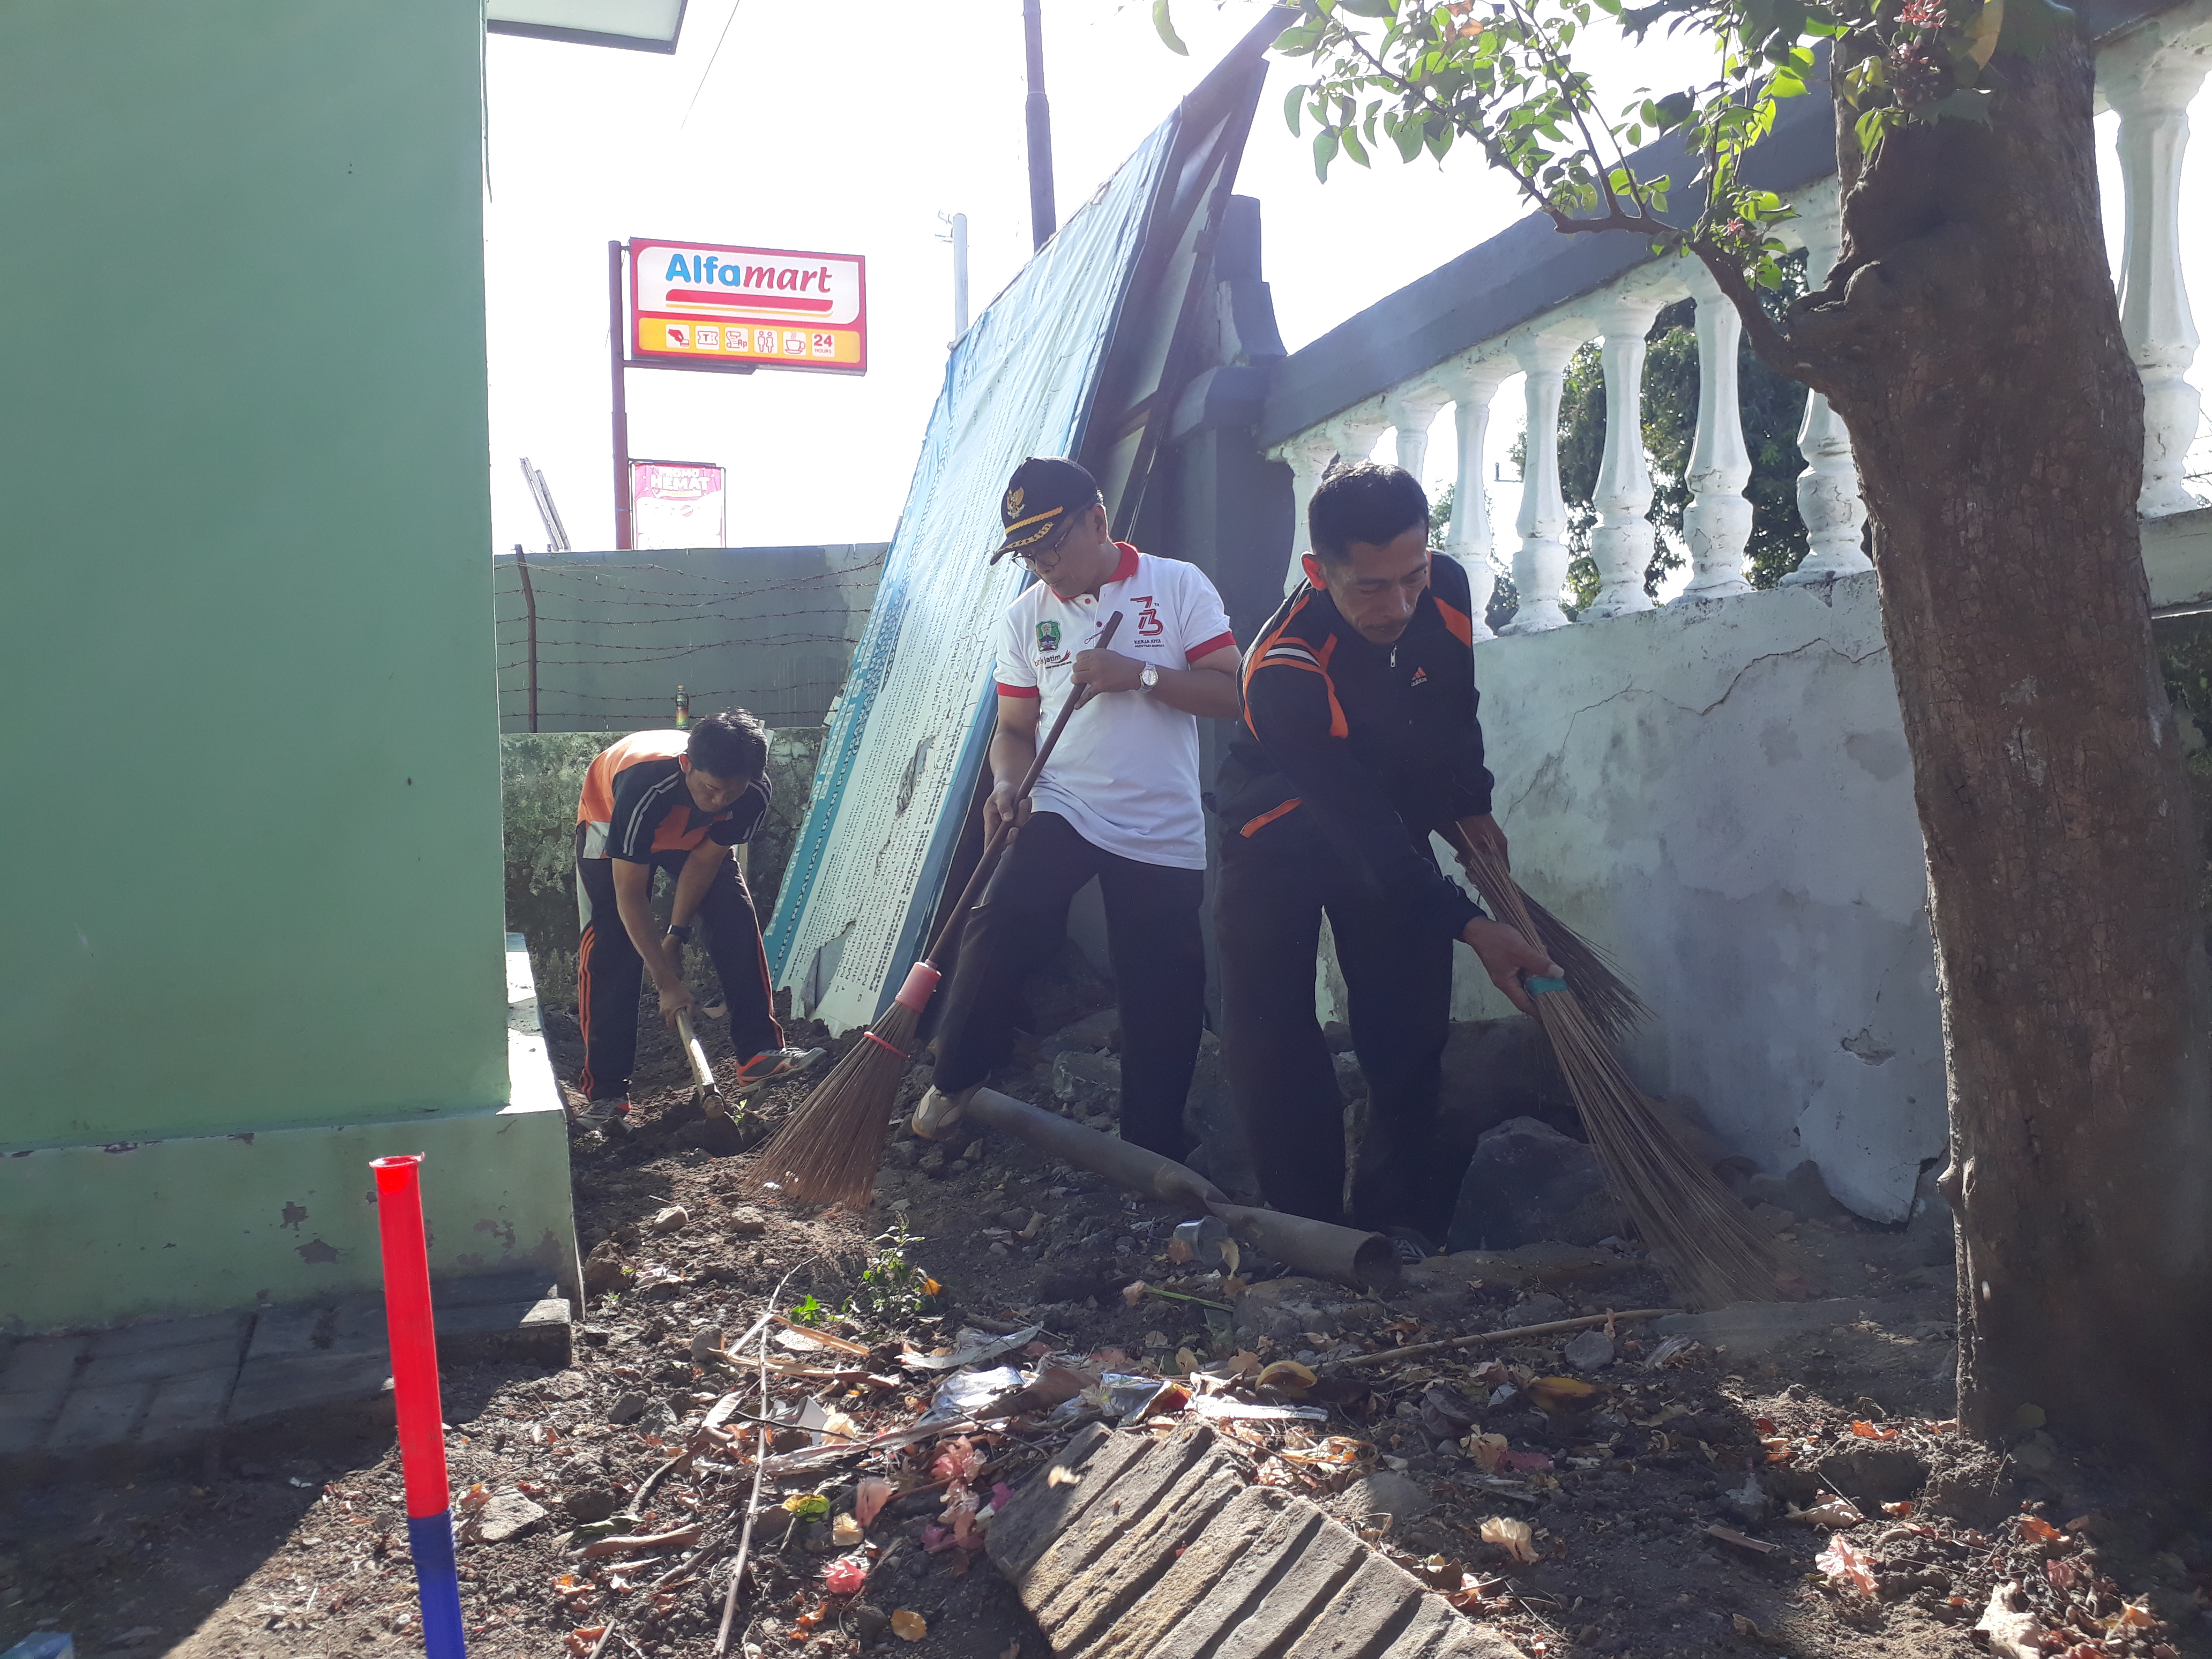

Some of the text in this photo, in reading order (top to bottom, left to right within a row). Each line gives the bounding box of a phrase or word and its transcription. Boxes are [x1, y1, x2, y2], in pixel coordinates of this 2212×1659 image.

[666, 253, 833, 293] Alfamart
[738, 340, 748, 348] Rp
[813, 334, 833, 347] 24
[651, 474, 710, 491] HEMAT
[820, 790, 839, 832] DAN
[914, 443, 950, 540] MINUMAN
[861, 607, 893, 692] TENTANG
[817, 586, 893, 802] NOMOR 8 TAHUN
[895, 715, 909, 746] yang
[870, 783, 881, 807] dan
[874, 796, 888, 827] yang
[885, 755, 901, 793] dapat
[816, 853, 835, 902] dilarang
[844, 885, 881, 981] Mengedarkan
[879, 821, 902, 881] dan/atau
[855, 939, 874, 985] Tanda
[898, 829, 911, 857] dan
[868, 898, 903, 992] Pelanggaran
[900, 828, 926, 895] terhadap
[872, 899, 907, 994] administrasi
[905, 828, 931, 896] dan/atau
[850, 923, 873, 983] dibawah
[871, 890, 885, 920] usia
[883, 870, 892, 887] 21
